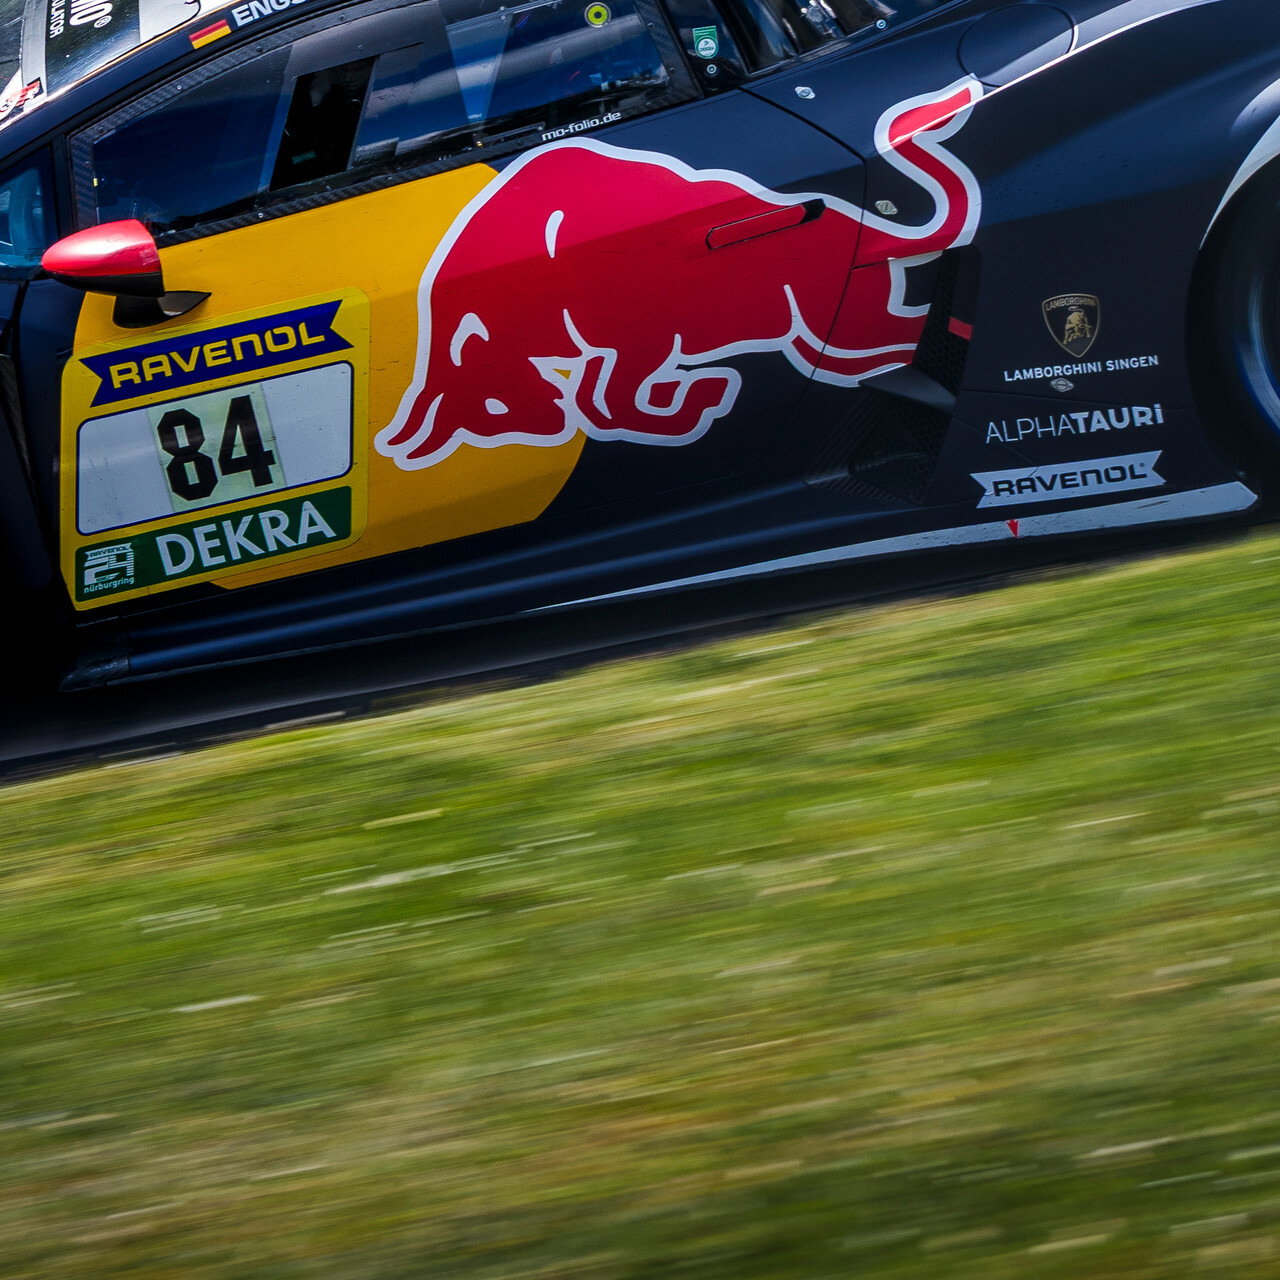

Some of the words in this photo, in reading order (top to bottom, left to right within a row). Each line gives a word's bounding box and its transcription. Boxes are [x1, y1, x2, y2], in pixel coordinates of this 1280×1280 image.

[541, 111, 621, 141] mo-folio.de
[109, 322, 325, 389] RAVENOL
[1004, 361, 1102, 382] LAMBORGHINI
[1106, 355, 1159, 371] SINGEN
[157, 394, 276, 501] 84
[992, 464, 1147, 497] RAVENOL
[155, 500, 337, 576] DEKRA
